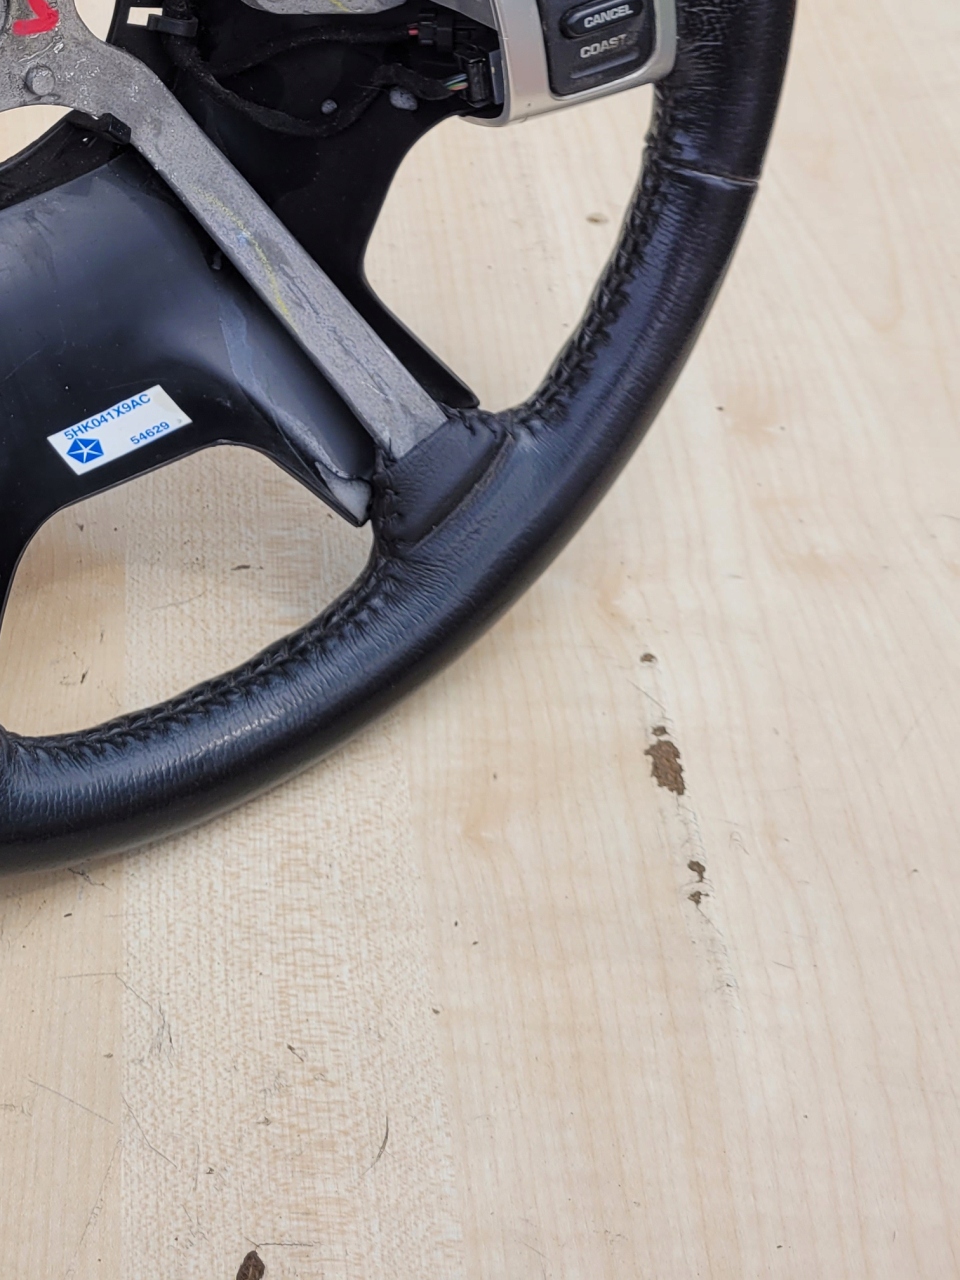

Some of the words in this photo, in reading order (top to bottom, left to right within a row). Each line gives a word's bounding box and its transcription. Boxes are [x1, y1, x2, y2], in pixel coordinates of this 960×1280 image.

[583, 4, 634, 29] CANCEL
[580, 34, 628, 59] COAST
[64, 393, 151, 441] 5HK041X9AC
[130, 421, 170, 445] 54629
